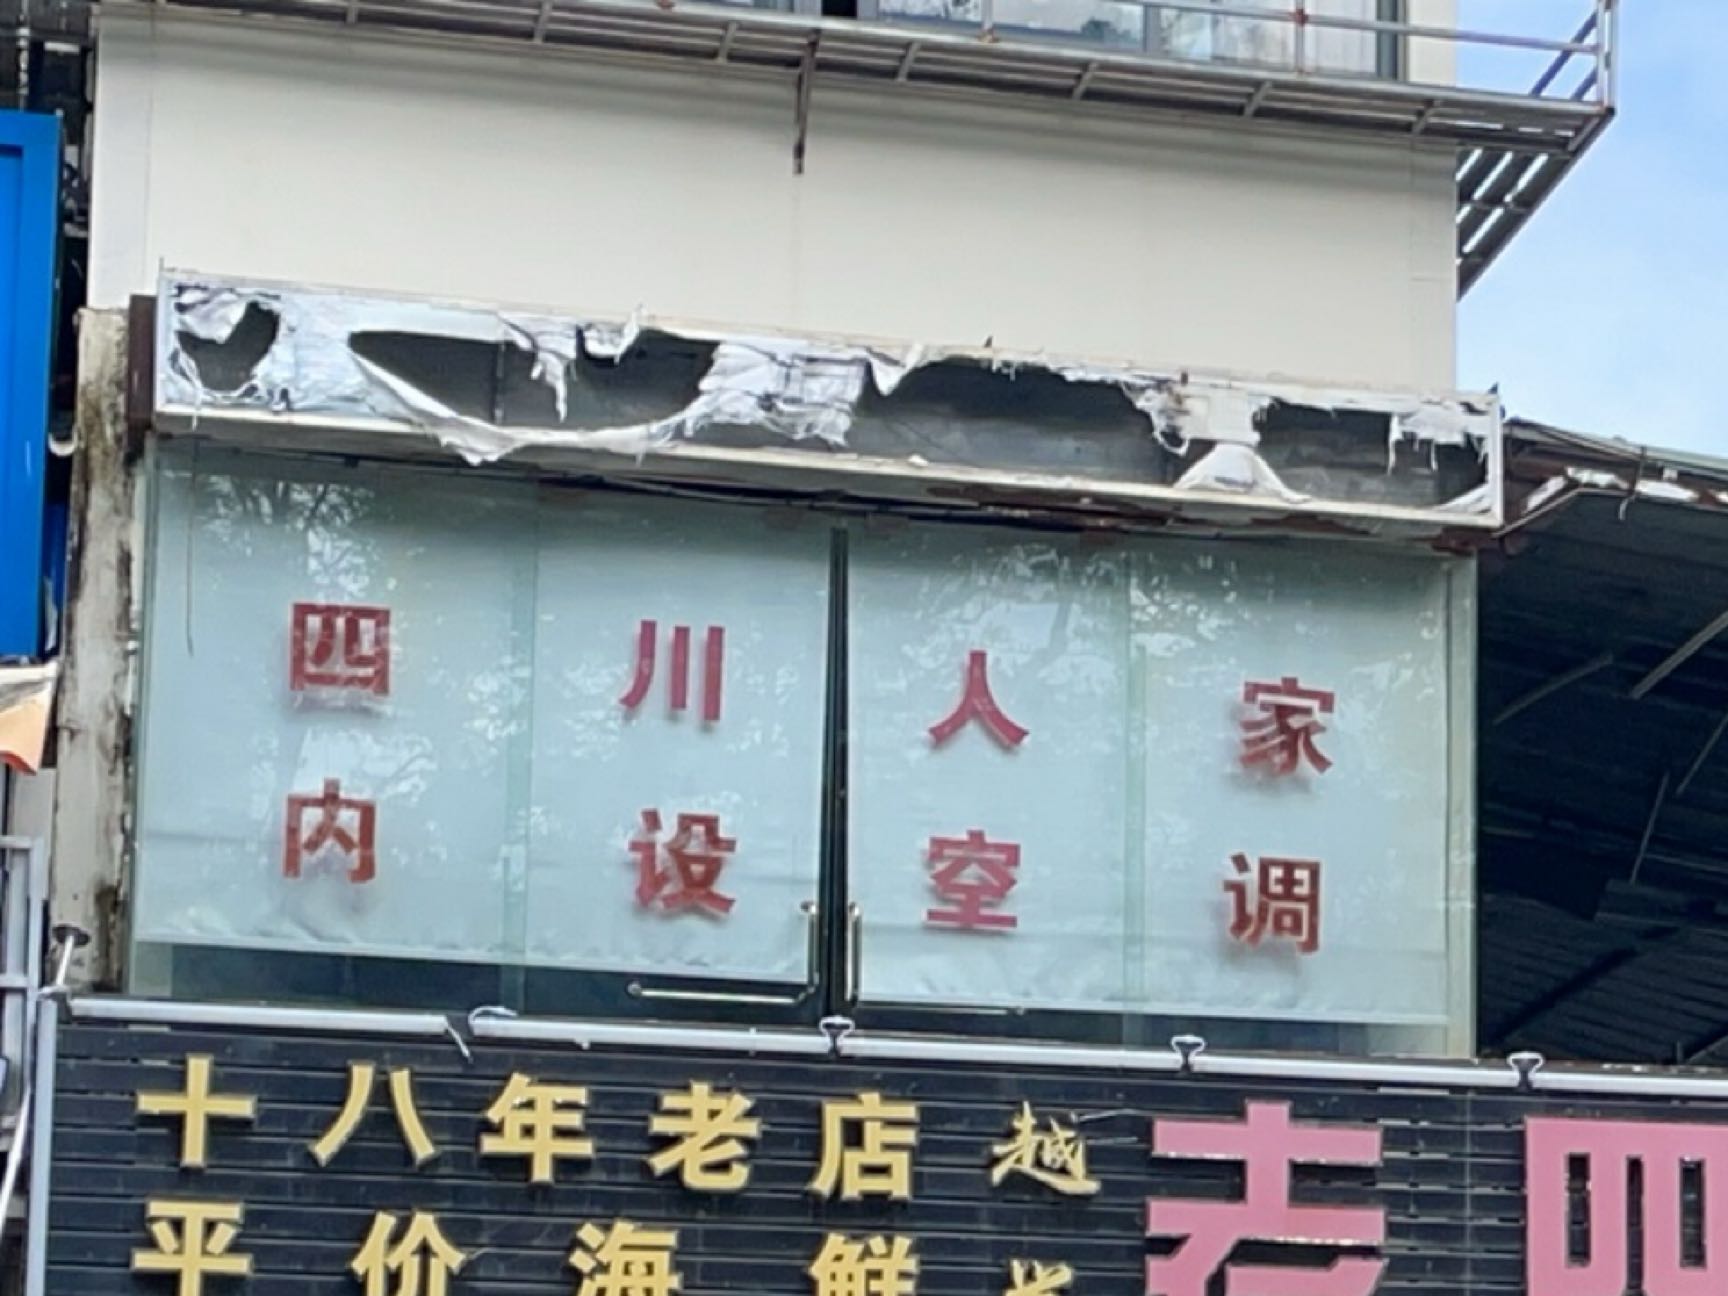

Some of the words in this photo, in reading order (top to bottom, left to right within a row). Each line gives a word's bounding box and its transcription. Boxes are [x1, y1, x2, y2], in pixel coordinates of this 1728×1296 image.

[290, 602, 1336, 776] 四川人家
[280, 777, 1323, 955] 内设空调
[136, 1054, 919, 1200] 十八年老店
